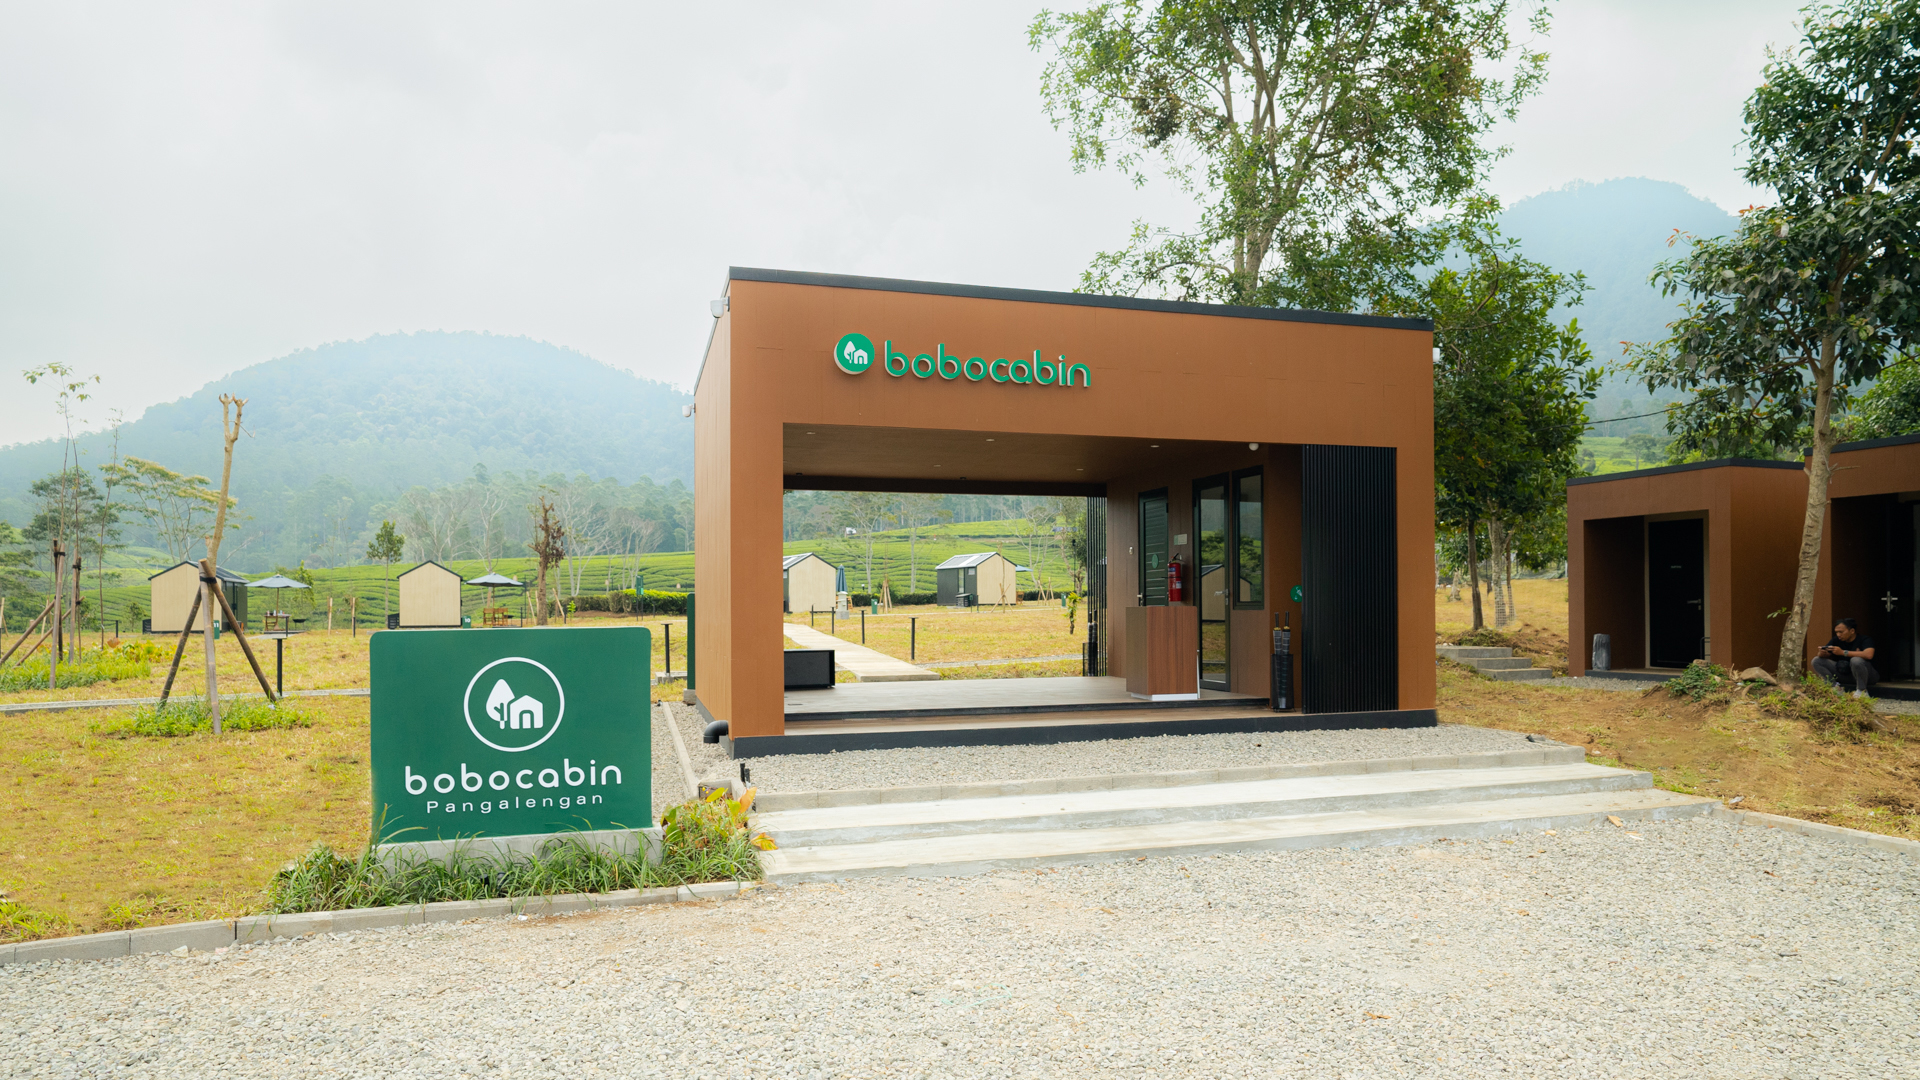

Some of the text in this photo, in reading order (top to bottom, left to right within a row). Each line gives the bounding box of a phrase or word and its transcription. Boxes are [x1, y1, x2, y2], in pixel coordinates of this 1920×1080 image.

[885, 339, 1092, 388] bobocabin
[405, 758, 622, 796] bobocabin
[426, 794, 603, 814] Pangalengan
